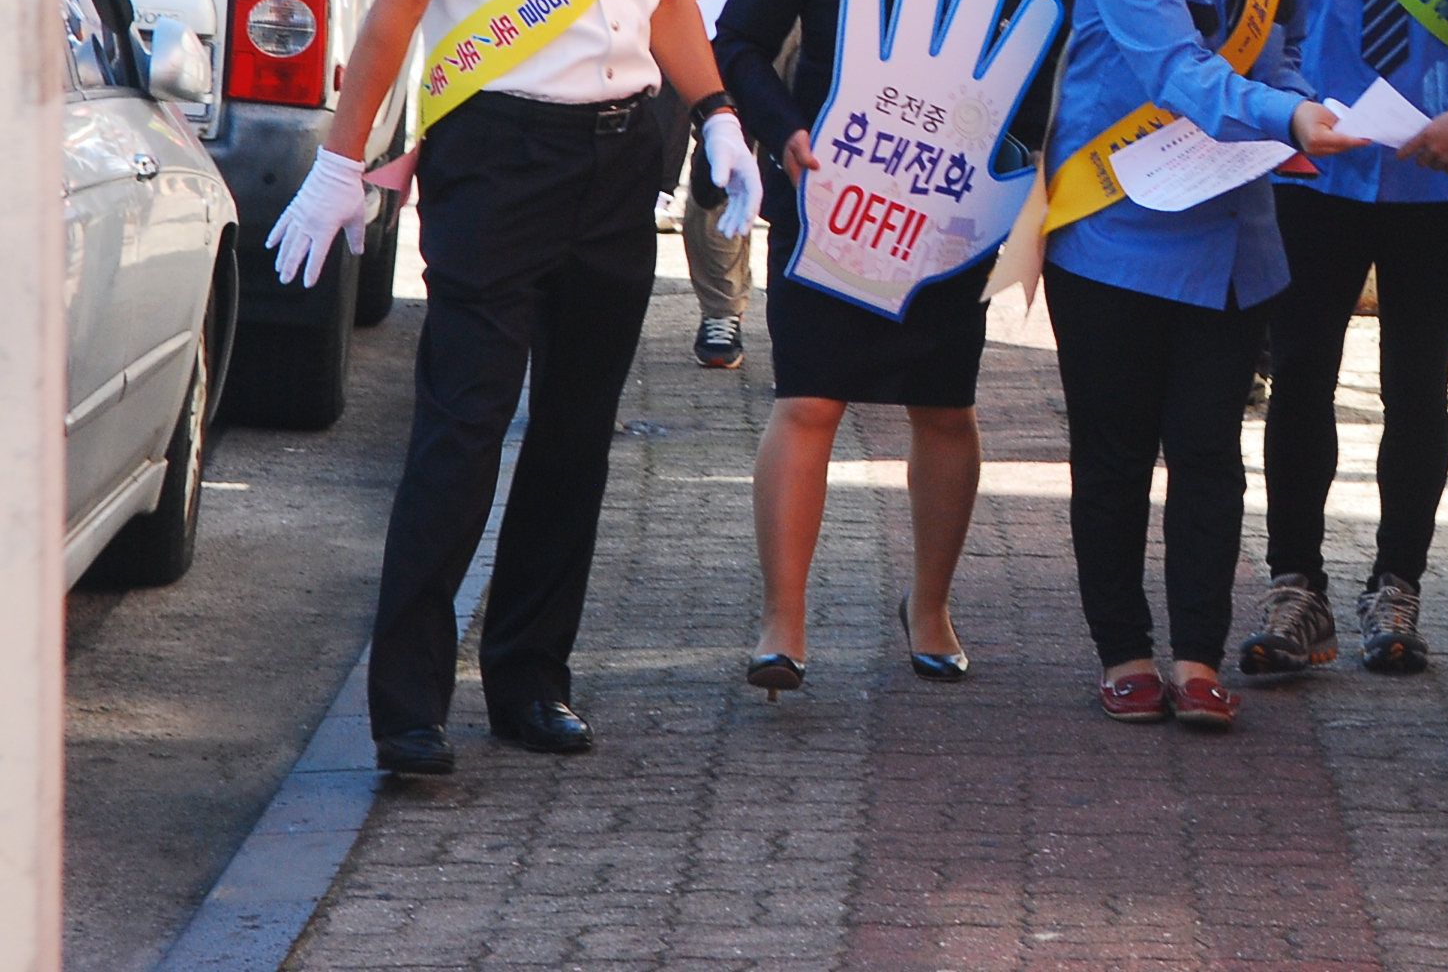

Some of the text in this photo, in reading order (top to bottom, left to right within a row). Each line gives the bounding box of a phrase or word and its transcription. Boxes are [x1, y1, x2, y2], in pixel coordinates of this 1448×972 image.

[876, 85, 947, 134] 운전중
[831, 112, 976, 204] 휴대전화
[828, 184, 929, 263] OFF!!
